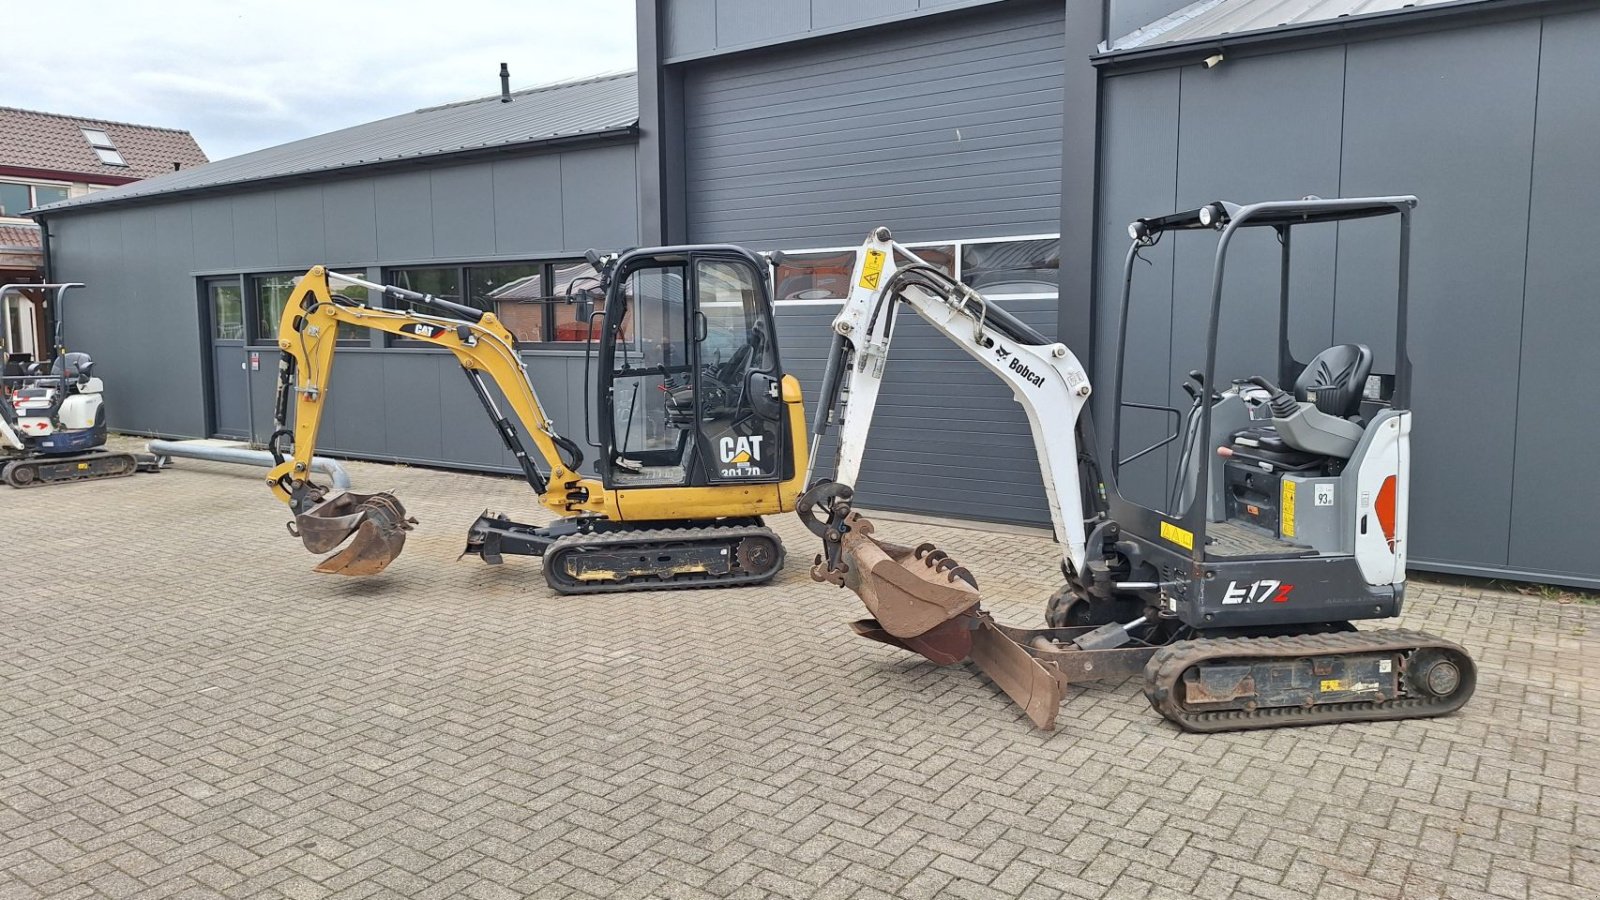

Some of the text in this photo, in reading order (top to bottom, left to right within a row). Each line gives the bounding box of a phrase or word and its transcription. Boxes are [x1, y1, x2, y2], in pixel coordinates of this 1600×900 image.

[414, 324, 434, 337] CAT
[1009, 357, 1046, 388] Bobcat
[719, 435, 763, 463] CAT
[1318, 493, 1328, 504] 93
